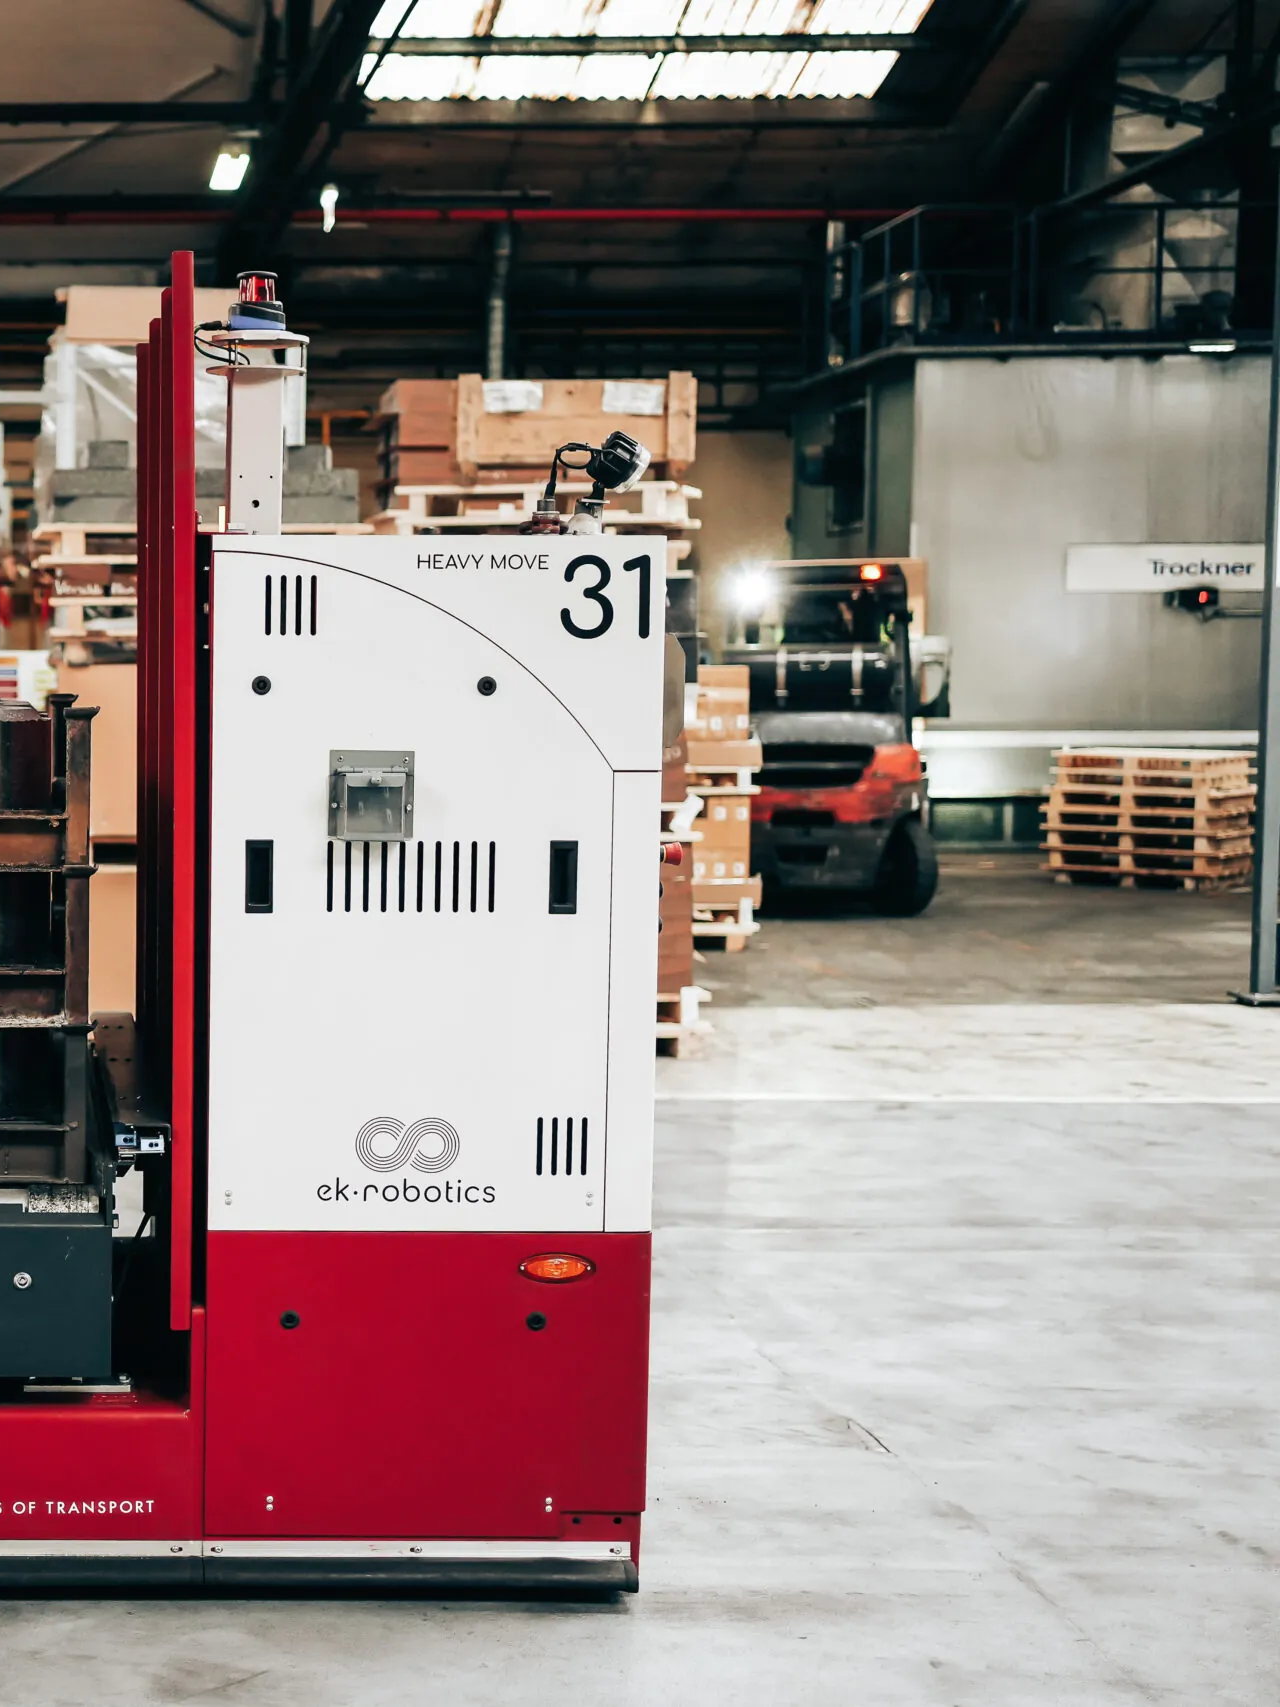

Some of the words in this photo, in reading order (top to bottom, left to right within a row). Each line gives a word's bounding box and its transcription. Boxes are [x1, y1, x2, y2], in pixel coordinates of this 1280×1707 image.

[418, 553, 483, 570] HEAVY
[490, 553, 550, 570] MOVE
[1149, 558, 1256, 577] Trockner
[560, 554, 651, 640] 31
[12, 1500, 36, 1515] OF
[45, 1499, 155, 1515] TRANSPORT
